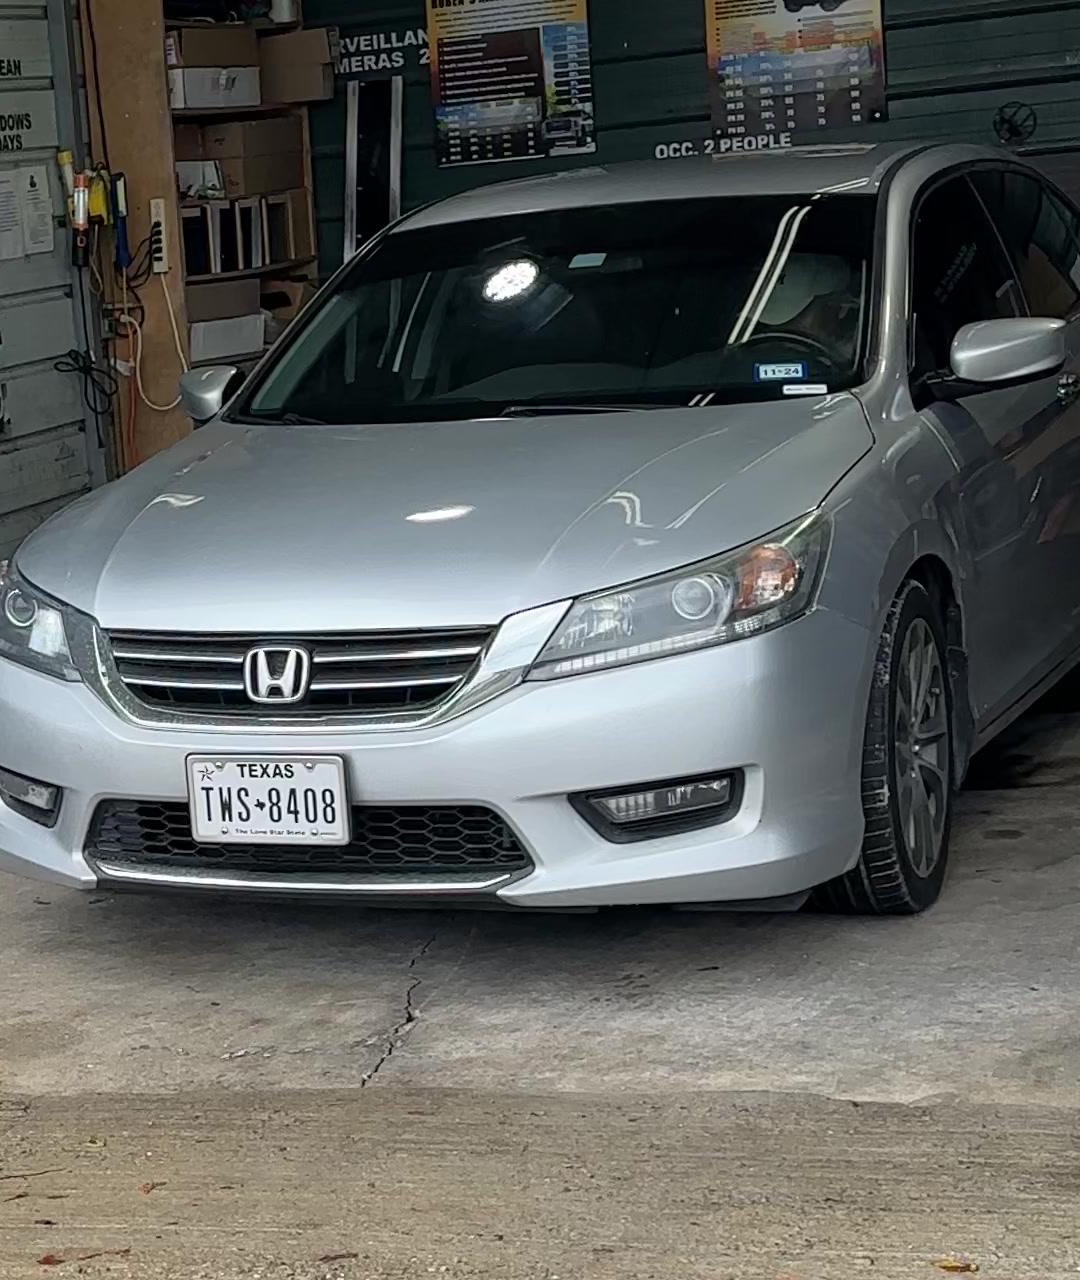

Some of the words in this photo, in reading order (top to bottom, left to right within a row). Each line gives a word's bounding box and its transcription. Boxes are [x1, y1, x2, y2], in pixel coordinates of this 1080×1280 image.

[334, 51, 405, 75] MERAS
[654, 141, 699, 160] OCC.
[704, 138, 715, 155] 2
[720, 131, 792, 154] PEOPLE
[236, 763, 295, 779] TEXAS
